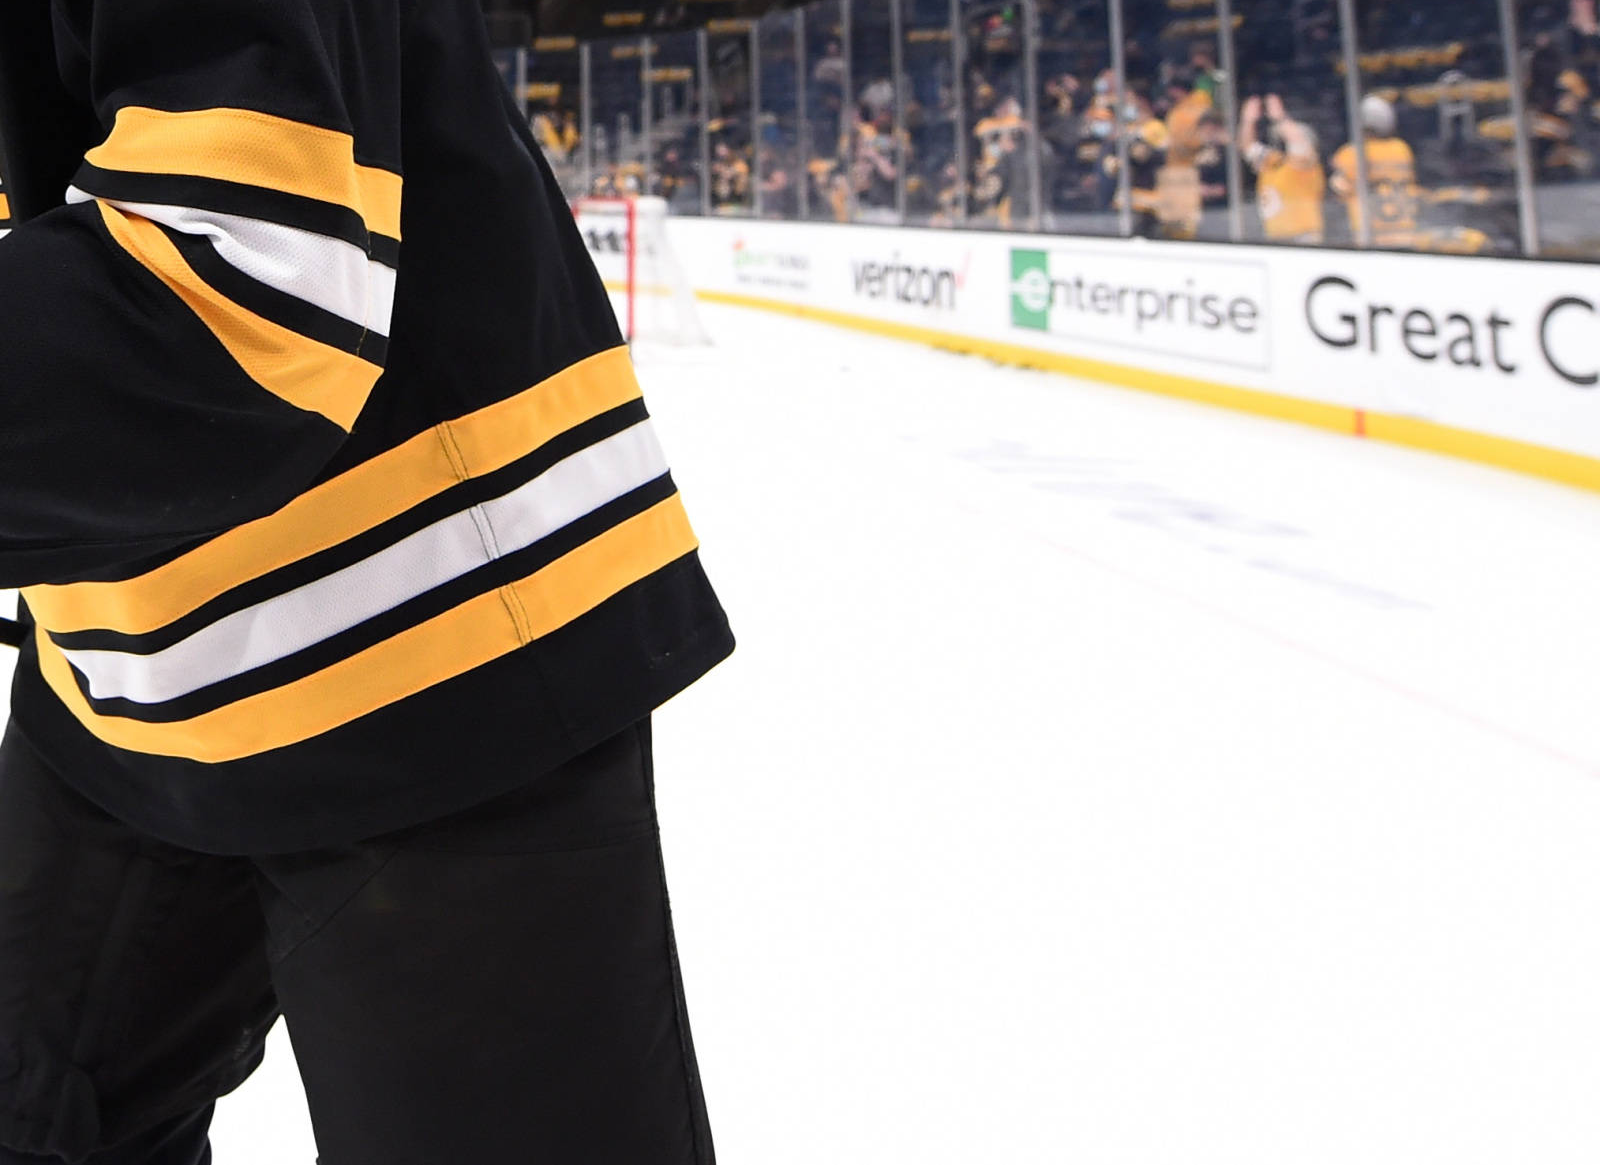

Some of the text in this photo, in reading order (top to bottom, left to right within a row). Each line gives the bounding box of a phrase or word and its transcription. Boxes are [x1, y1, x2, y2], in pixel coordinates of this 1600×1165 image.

[853, 250, 957, 310] verizon
[1010, 266, 1259, 333] enterprise
[1304, 276, 1516, 374] Great
